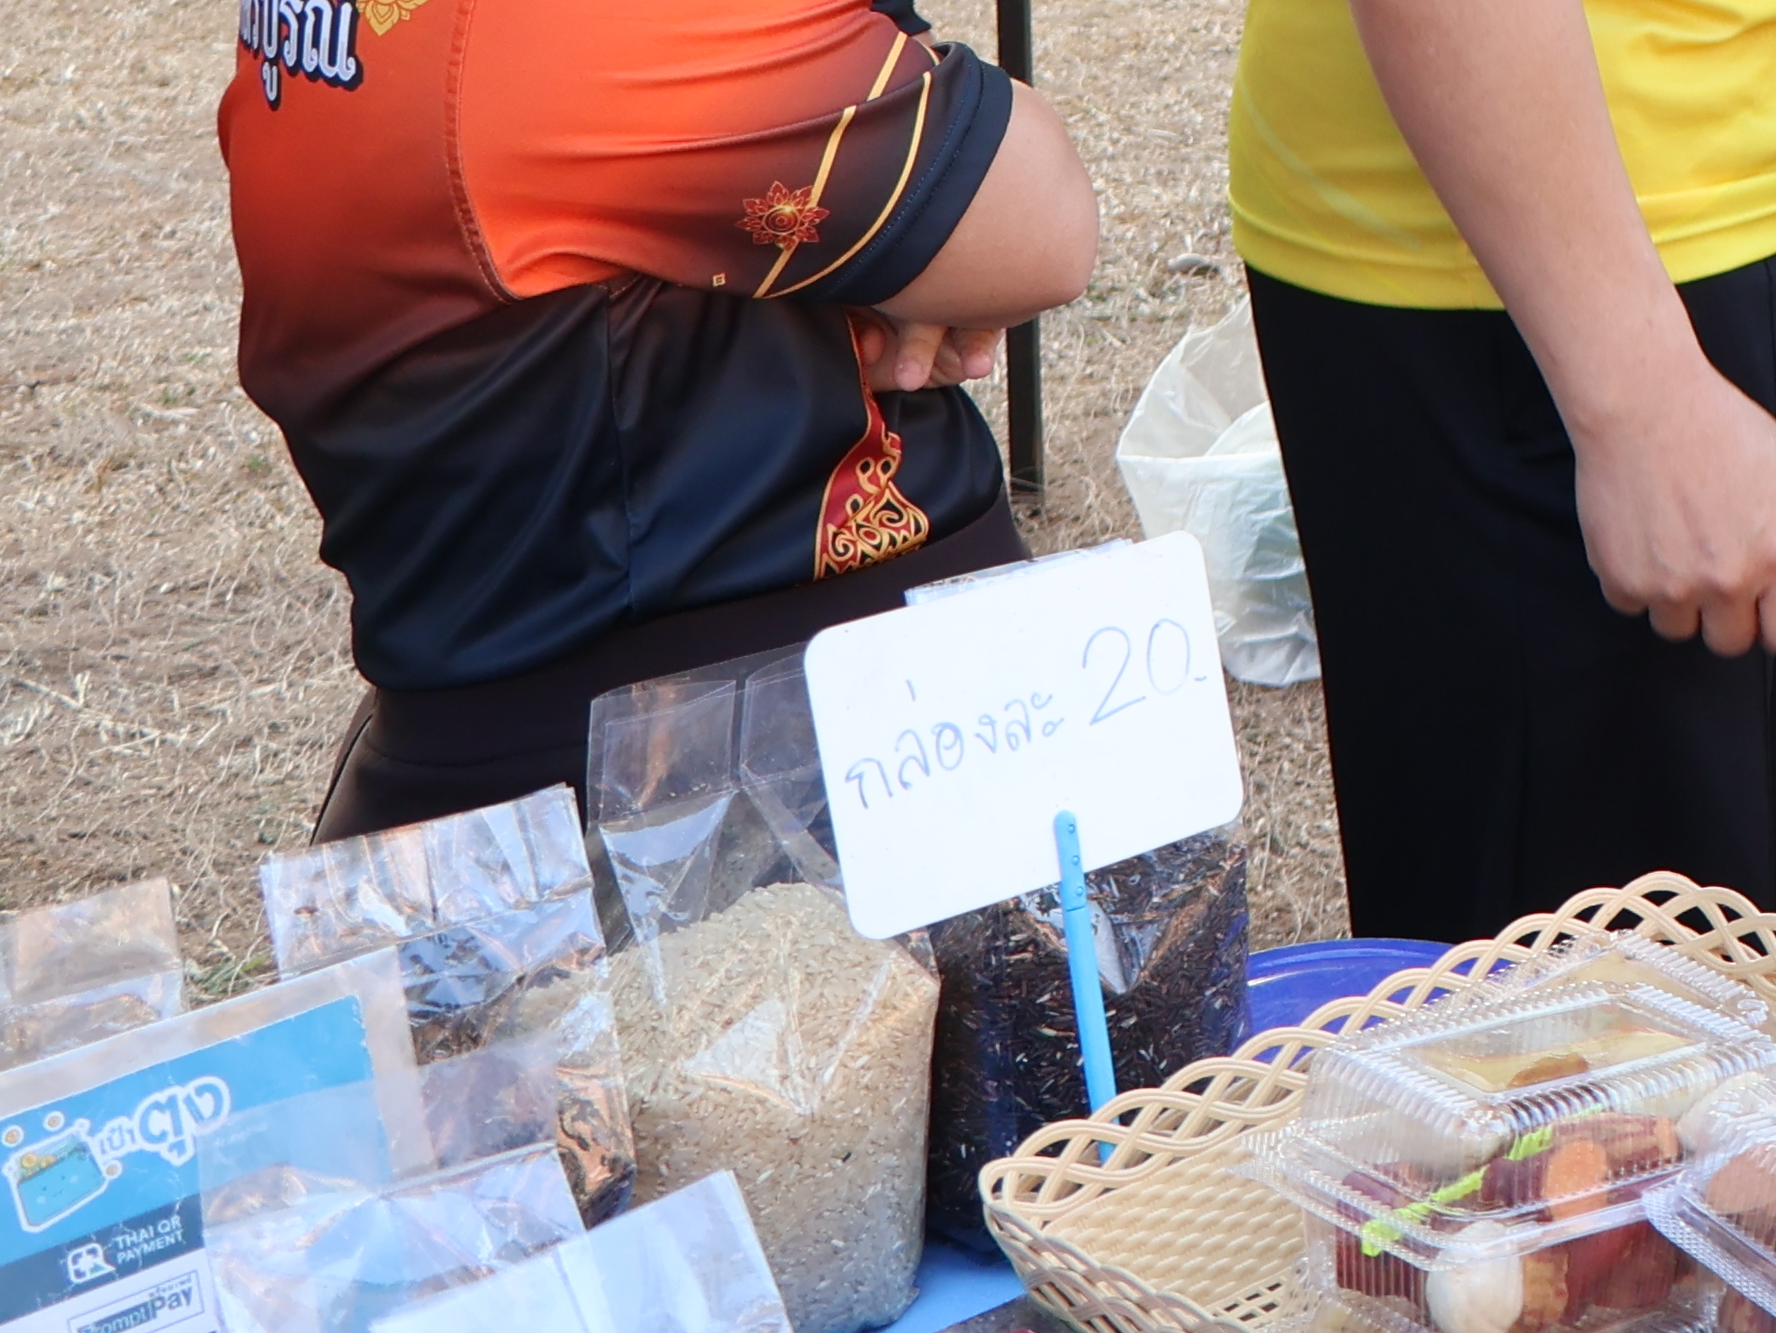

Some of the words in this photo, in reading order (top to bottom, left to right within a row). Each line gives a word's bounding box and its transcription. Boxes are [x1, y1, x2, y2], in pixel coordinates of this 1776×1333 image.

[844, 679, 1065, 810] กล่องละ
[115, 1224, 157, 1250] THAI
[156, 1214, 182, 1234] QR
[117, 1229, 184, 1265] PAYMENT
